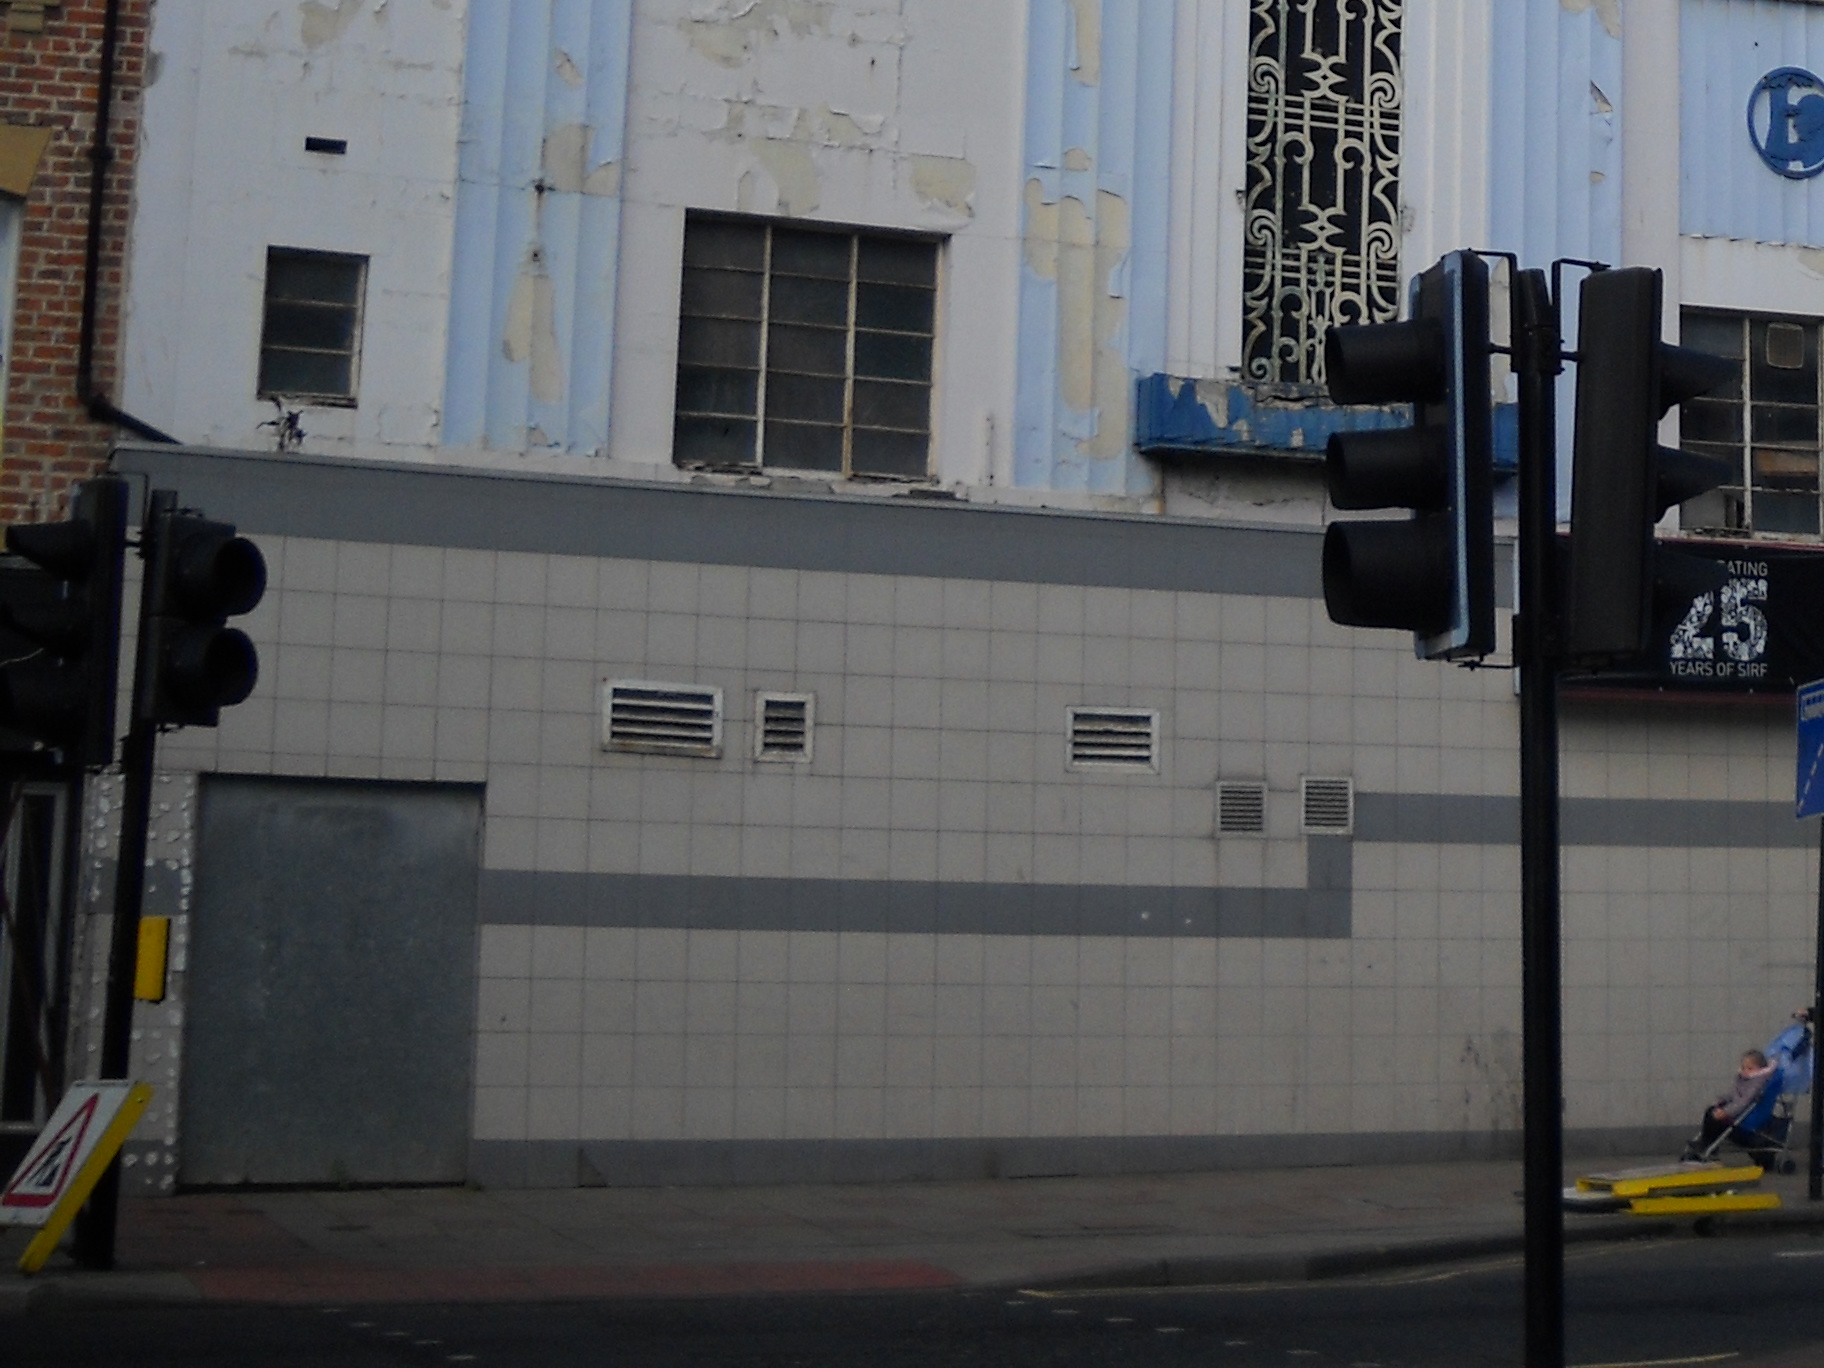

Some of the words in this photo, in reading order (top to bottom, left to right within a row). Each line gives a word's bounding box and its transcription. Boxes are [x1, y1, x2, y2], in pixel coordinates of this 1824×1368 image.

[1726, 560, 1768, 577] ATING
[1669, 661, 1714, 676] YEARS
[1716, 662, 1735, 677] OF
[1738, 663, 1768, 678] SIRF
